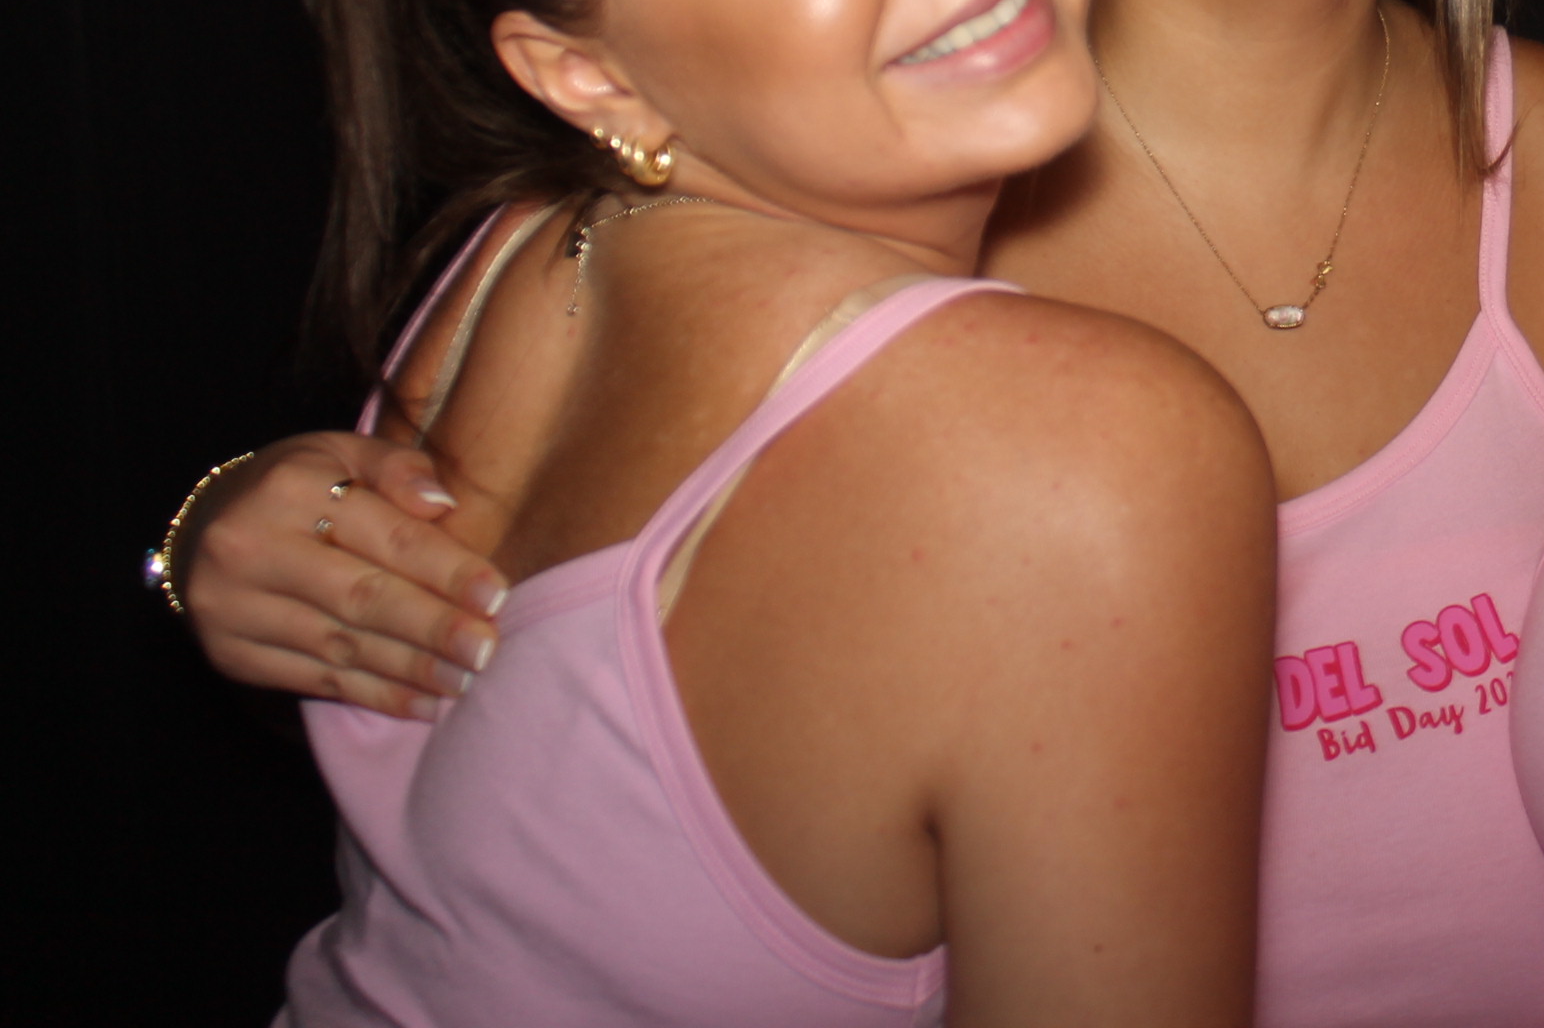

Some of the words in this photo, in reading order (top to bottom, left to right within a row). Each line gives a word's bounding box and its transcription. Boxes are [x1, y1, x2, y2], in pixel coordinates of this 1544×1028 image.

[1274, 641, 1384, 732] DEL
[1402, 593, 1520, 692] SOL
[1317, 721, 1377, 761] Bid
[1387, 704, 1465, 740] Day
[1474, 670, 1515, 715] 20
